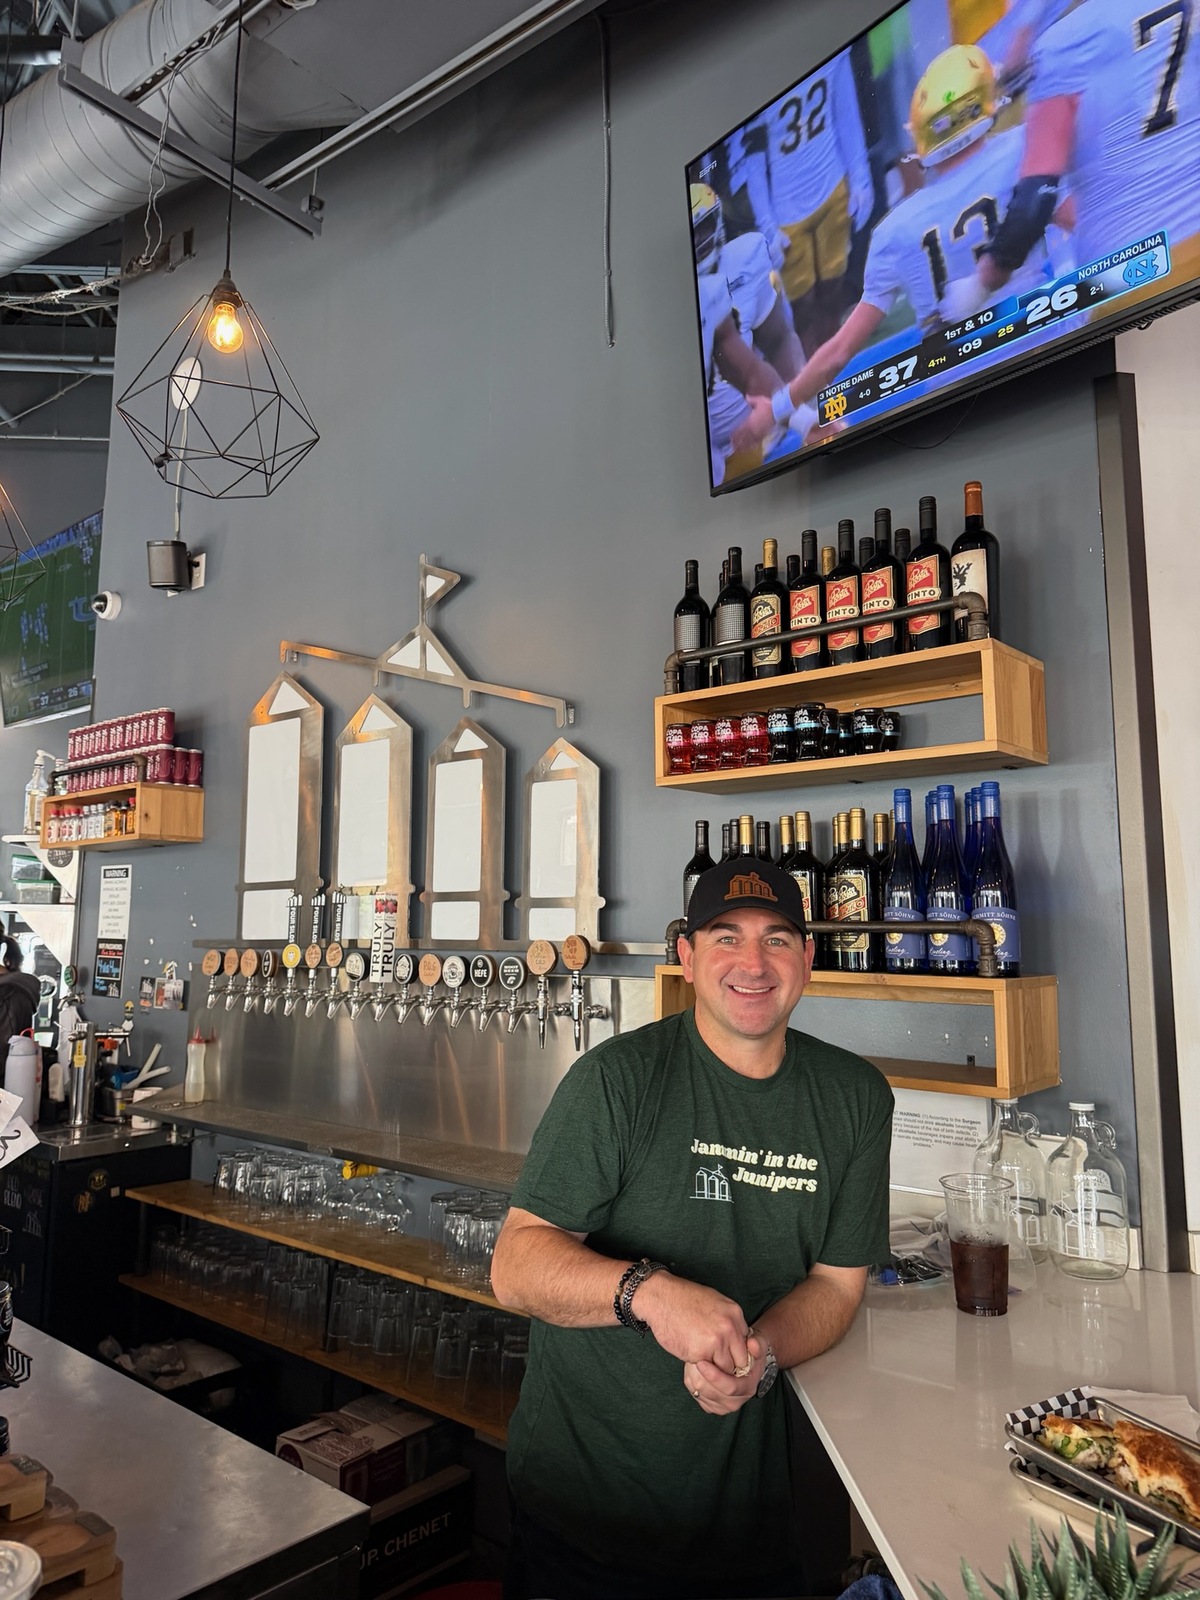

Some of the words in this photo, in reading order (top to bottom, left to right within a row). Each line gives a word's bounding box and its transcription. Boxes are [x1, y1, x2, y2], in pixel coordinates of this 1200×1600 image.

[1132, 0, 1193, 138] 7
[778, 78, 828, 156] 32
[699, 160, 717, 178] ESPN
[1078, 259, 1111, 280] NORTH
[1112, 234, 1162, 264] CAROLINA
[1089, 282, 1105, 296] 2-1
[1025, 283, 1078, 325] 26
[944, 327, 962, 341] 1ST
[964, 319, 976, 332] &
[978, 311, 994, 325] 10
[998, 324, 1014, 338] 25
[958, 338, 982, 357] :09
[928, 355, 946, 368] 4TH
[878, 355, 918, 390] 37
[826, 381, 851, 397] NOTRE
[852, 369, 874, 385] DAME
[858, 388, 871, 399] 4-0
[908, 589, 936, 601] TINTO
[828, 608, 855, 618] TINTO
[863, 600, 890, 610] TINTO
[792, 617, 816, 626] TINTO
[105, 869, 126, 878] WARNING
[894, 911, 915, 919] SÖHNE
[939, 911, 960, 920] SÖHNE
[996, 911, 1016, 920] SÖHNE
[371, 922, 382, 976] TRULY
[382, 922, 395, 977] TRULY
[474, 969, 488, 978] HEFE
[929, 1114, 948, 1122] According
[763, 1150, 784, 1168] in
[786, 1153, 819, 1172] the
[732, 1166, 818, 1193] Junipers
[384, 1512, 452, 1556] CHENET
